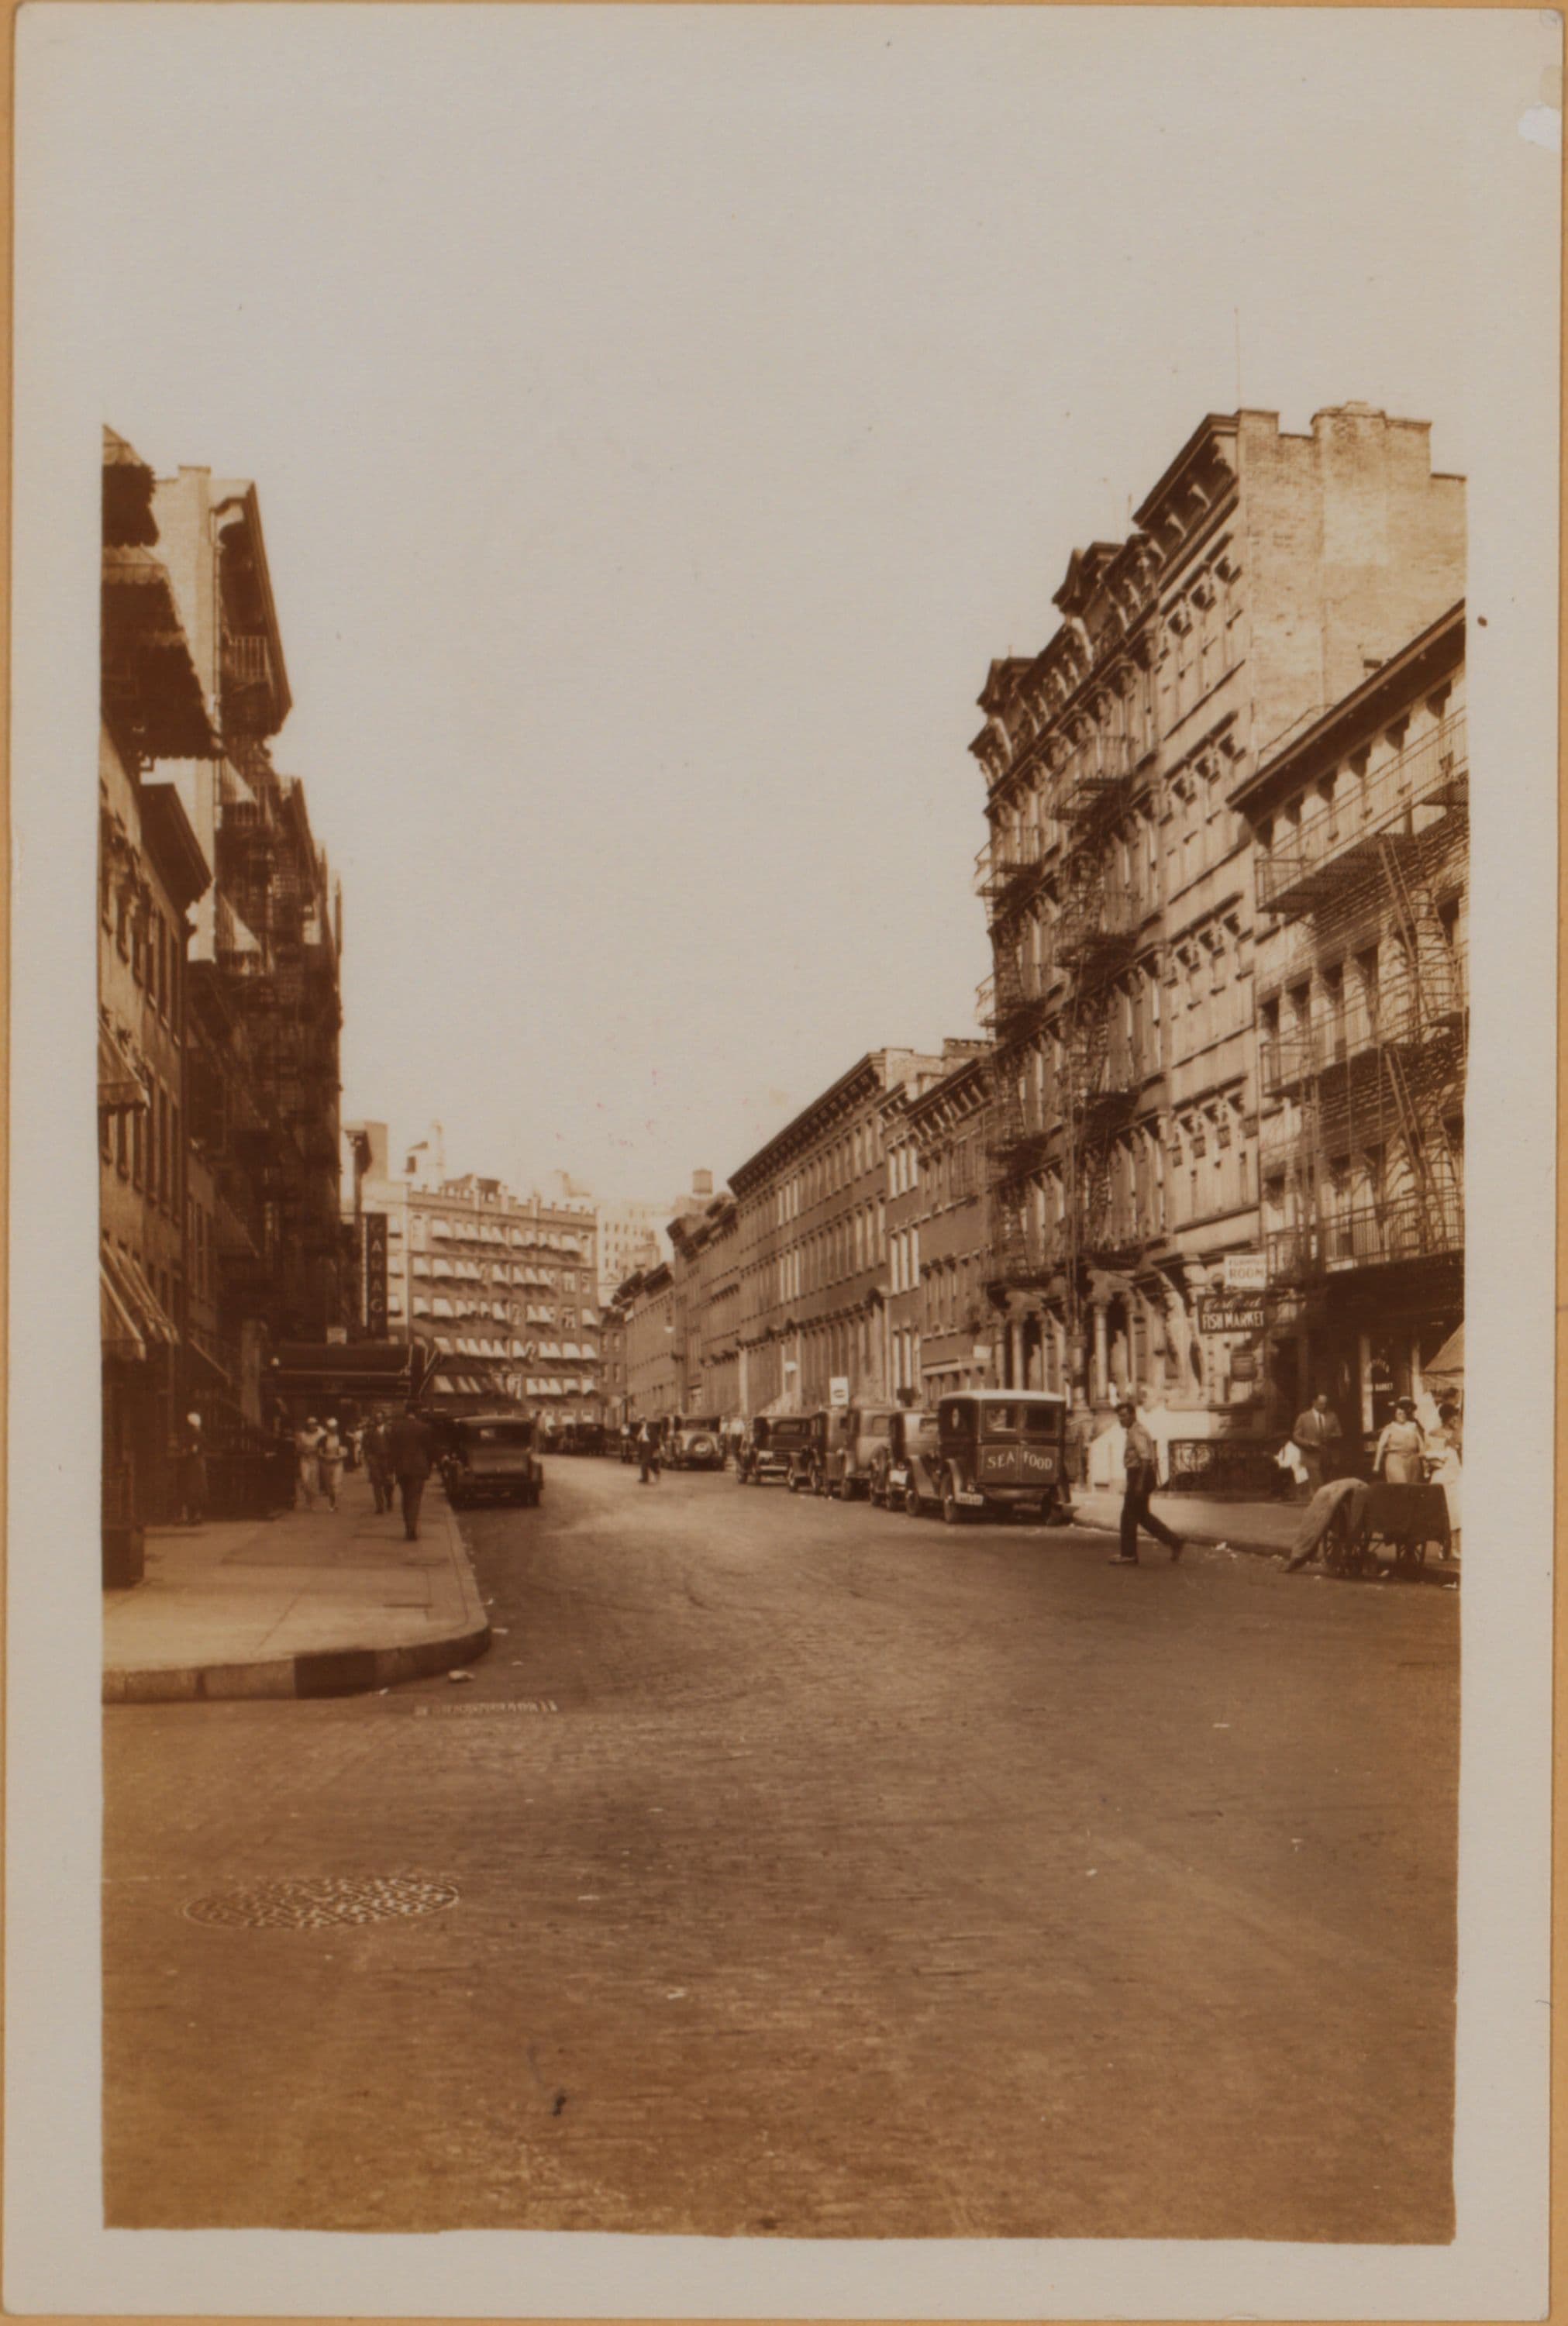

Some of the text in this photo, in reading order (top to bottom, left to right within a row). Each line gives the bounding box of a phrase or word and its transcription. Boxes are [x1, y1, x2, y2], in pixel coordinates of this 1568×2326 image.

[1202, 1311, 1264, 1330] FISH MARKET
[987, 1451, 1053, 1470] SEA FOOD
